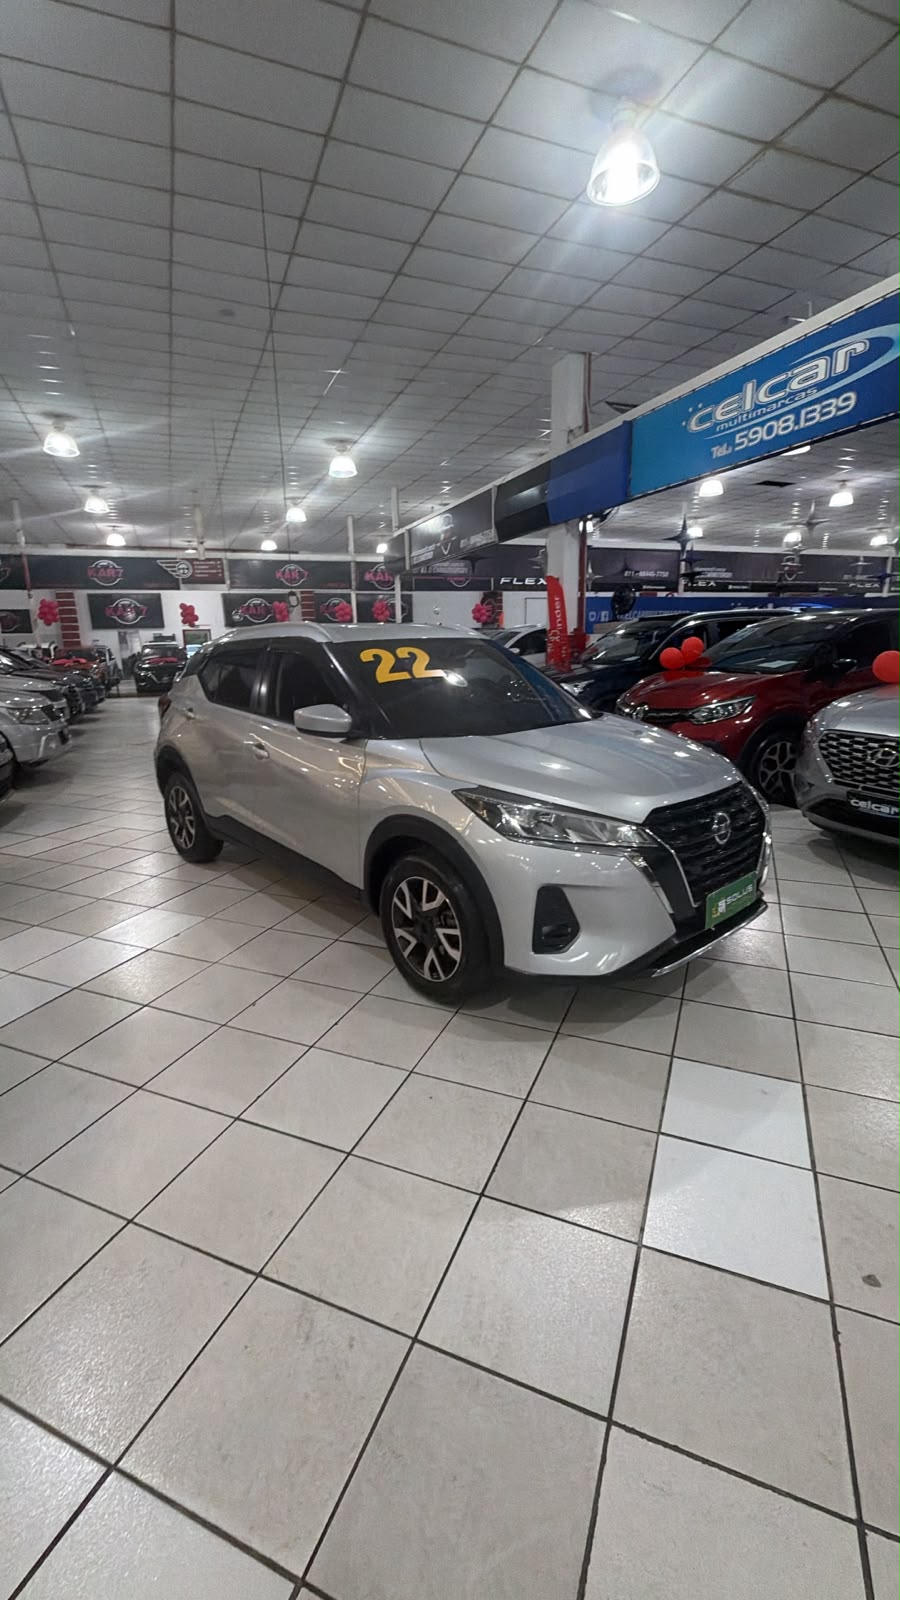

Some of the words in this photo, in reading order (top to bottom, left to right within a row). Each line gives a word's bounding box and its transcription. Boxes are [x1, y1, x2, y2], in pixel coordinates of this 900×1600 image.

[687, 339, 870, 432] celcar
[715, 386, 818, 431] multimarcas
[500, 577, 547, 585] FLEX
[360, 646, 445, 683] 22
[849, 799, 900, 815] celcar
